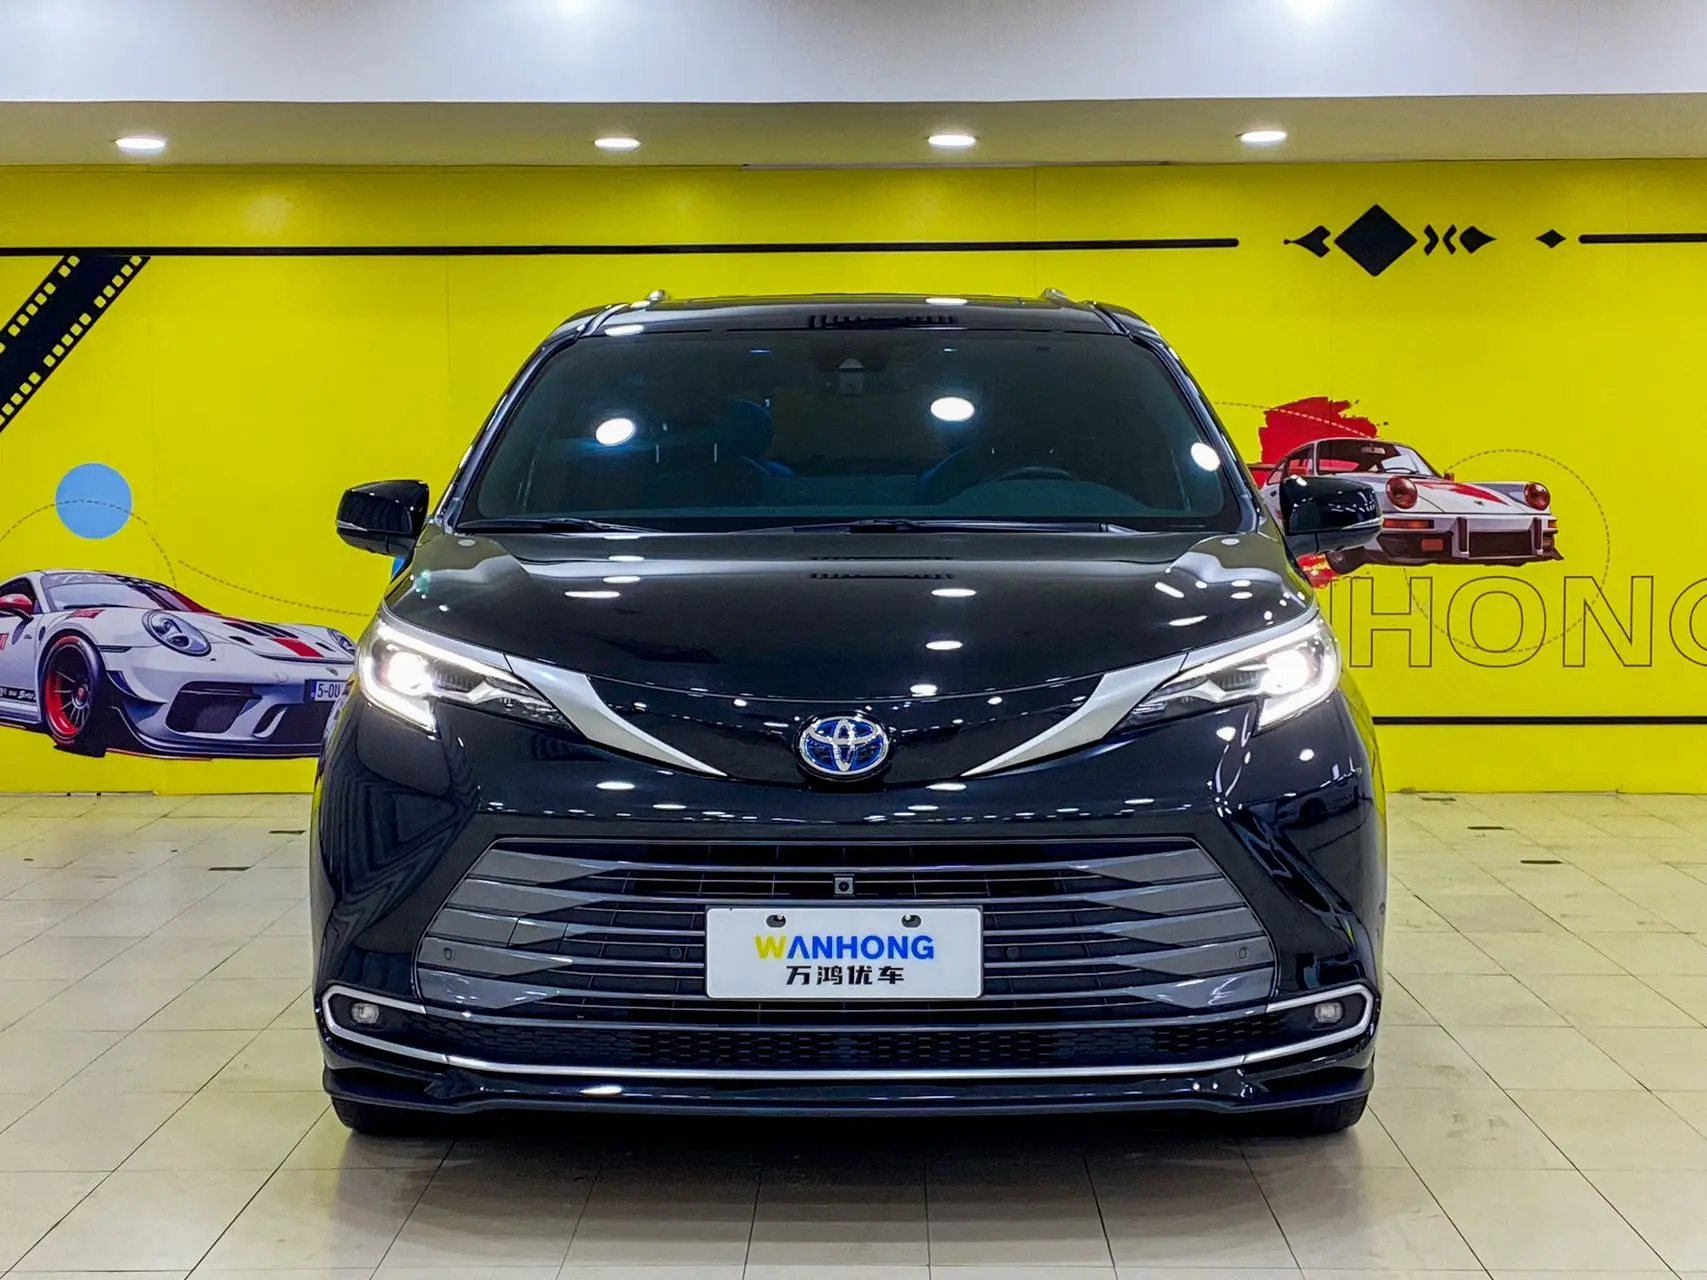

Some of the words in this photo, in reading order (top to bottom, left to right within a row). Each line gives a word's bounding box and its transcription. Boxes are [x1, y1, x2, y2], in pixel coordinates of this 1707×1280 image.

[1329, 575, 1707, 668] HON
[755, 935, 934, 960] WANHONG
[786, 965, 904, 985] 万鸿优车
